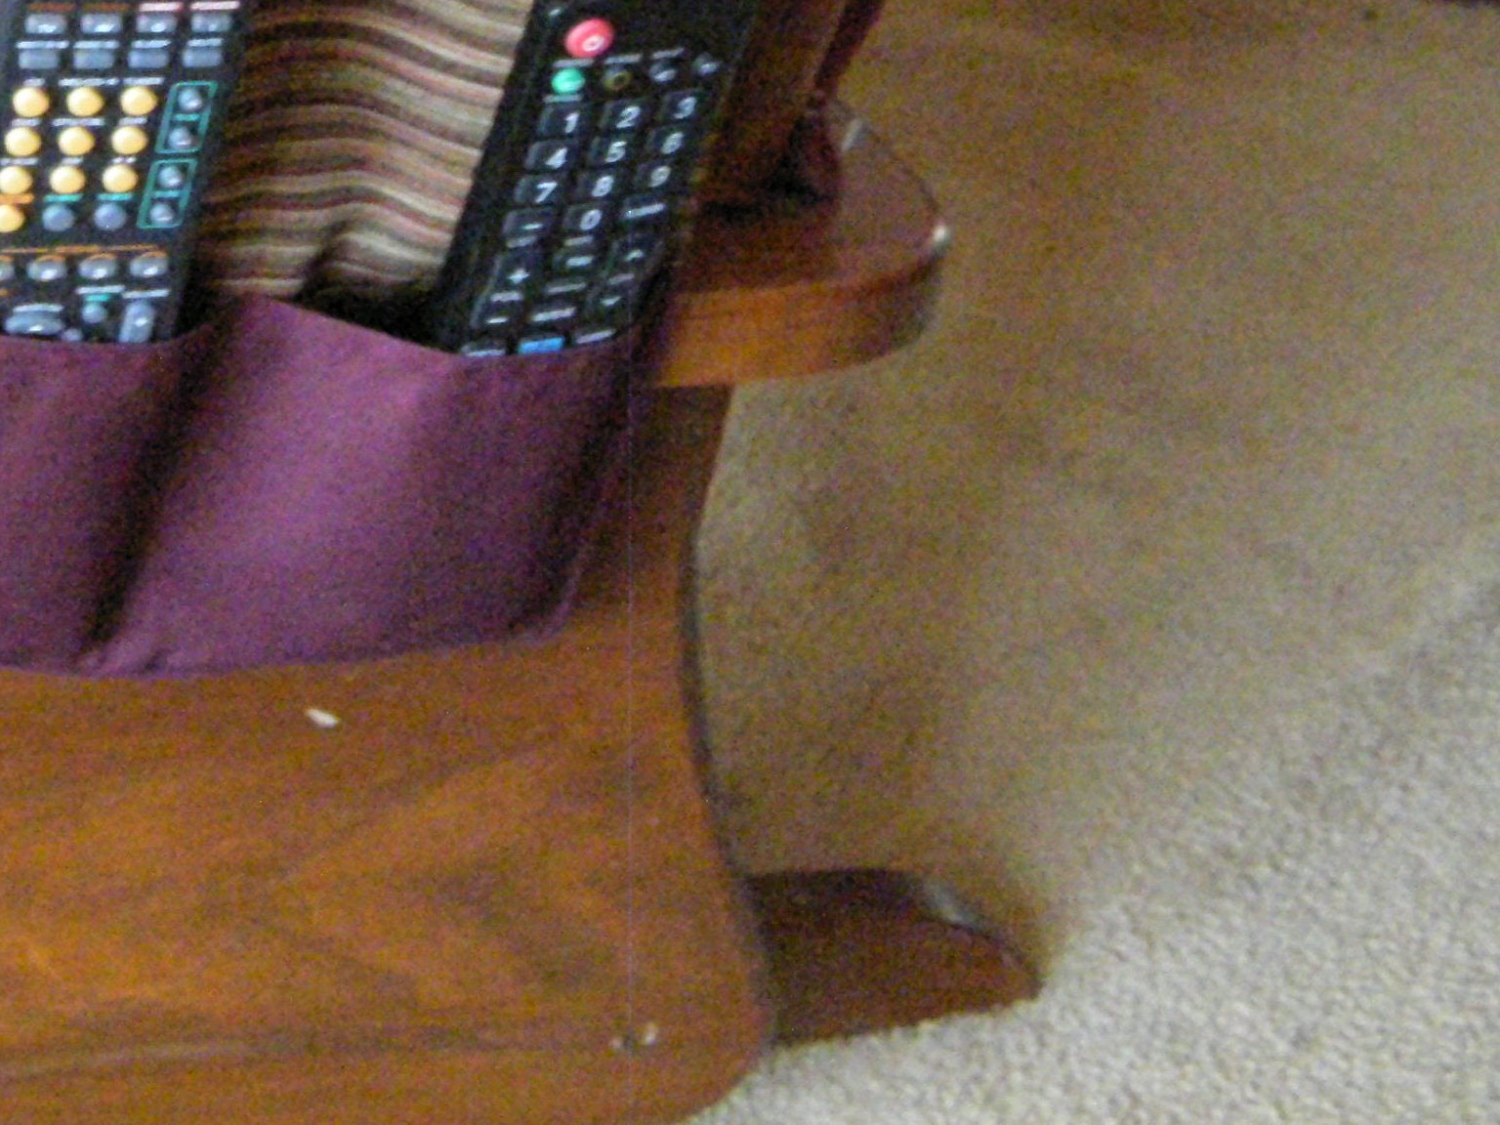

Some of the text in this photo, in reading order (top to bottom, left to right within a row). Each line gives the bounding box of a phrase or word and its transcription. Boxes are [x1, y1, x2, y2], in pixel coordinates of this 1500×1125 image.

[565, 96, 697, 133] 1 2 3
[545, 132, 684, 170] 4 5 6
[535, 181, 558, 203] 7
[591, 175, 614, 197] 8
[580, 209, 602, 231] 0
